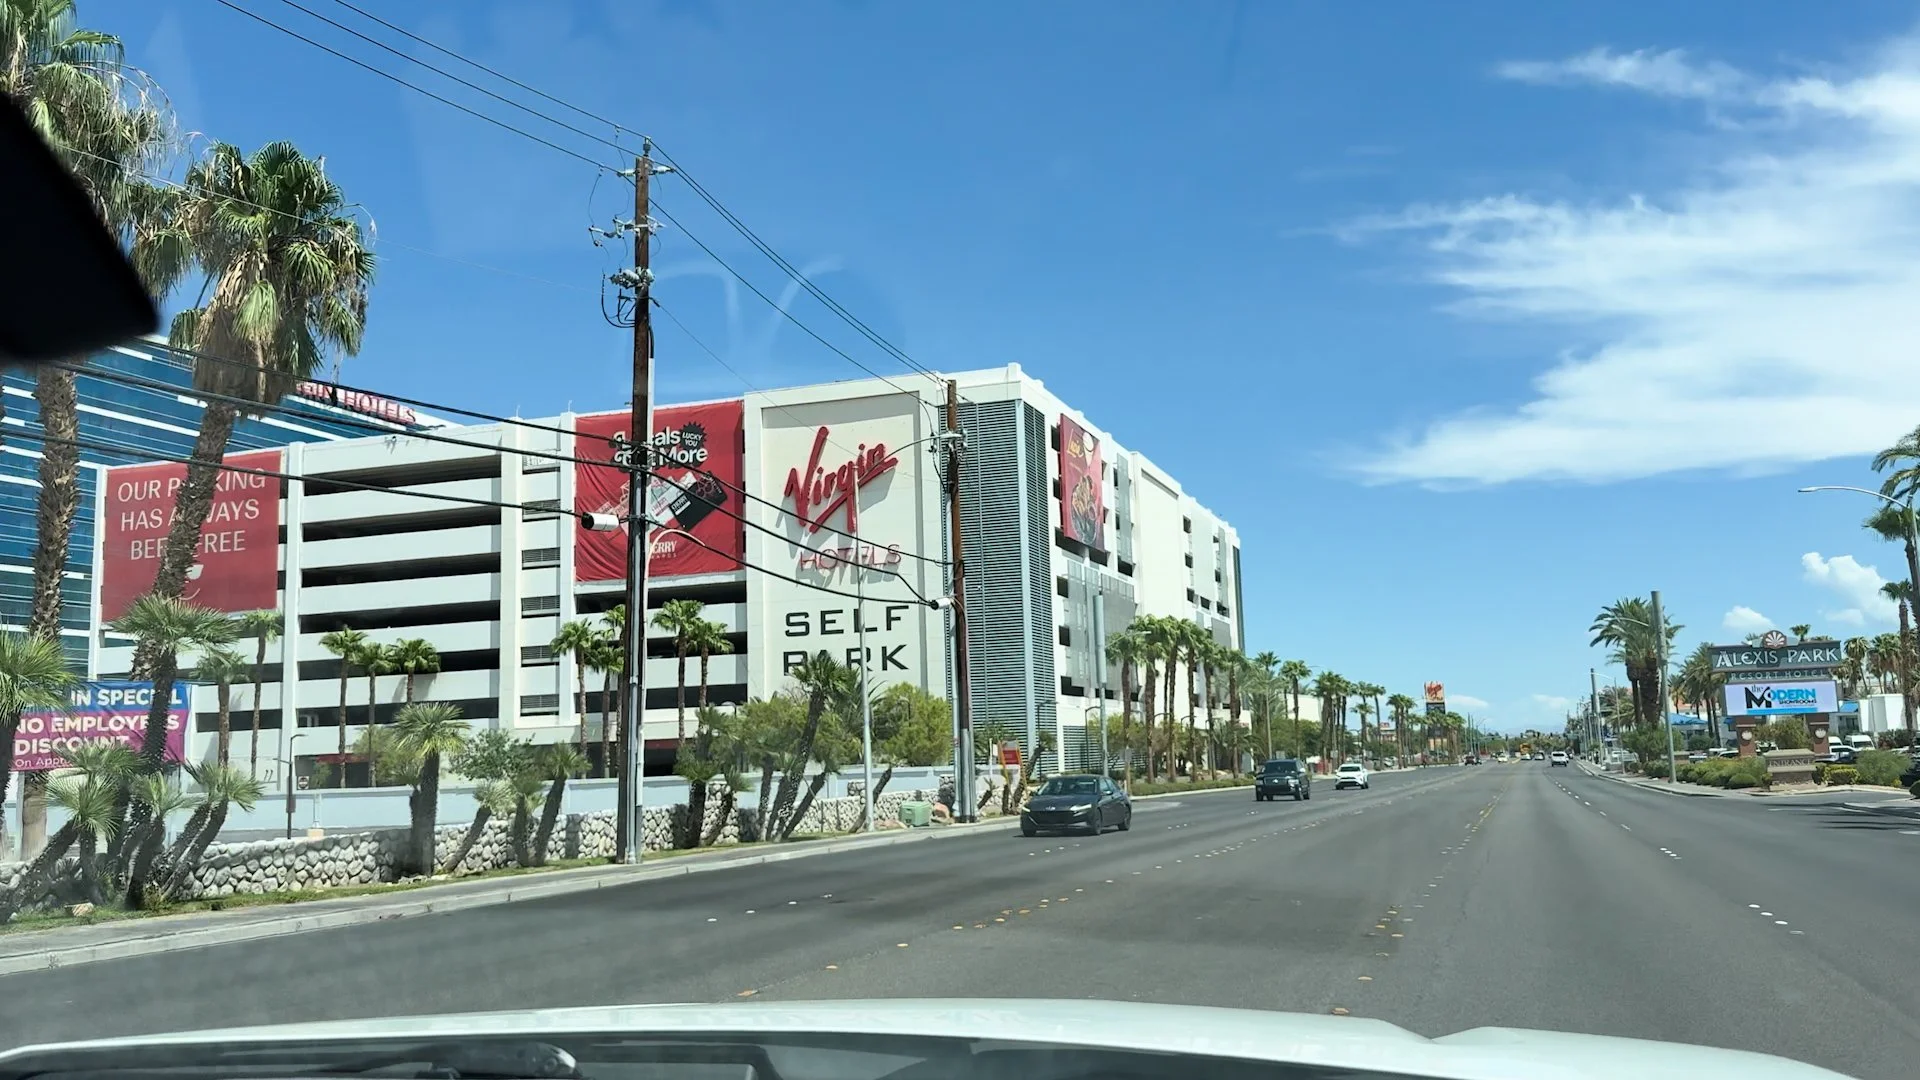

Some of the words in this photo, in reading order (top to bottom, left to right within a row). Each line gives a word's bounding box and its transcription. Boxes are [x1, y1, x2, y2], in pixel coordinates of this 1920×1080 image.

[682, 432, 702, 441] LUCKY
[659, 447, 708, 466] More
[118, 480, 160, 502] OUR
[167, 468, 265, 497] PKING
[784, 426, 898, 534] Virgin
[121, 508, 162, 531] HAS
[800, 544, 902, 572] HOTELS
[785, 605, 909, 637] SELF
[783, 644, 909, 676] PRK
[1716, 650, 1778, 667] ALEXIS
[1787, 648, 1838, 663] PARK
[1731, 671, 1779, 680] RESORT
[1785, 670, 1826, 679] HOTEL
[1751, 685, 1764, 693] the
[51, 714, 180, 733] EMPLOYES
[15, 759, 32, 768] On
